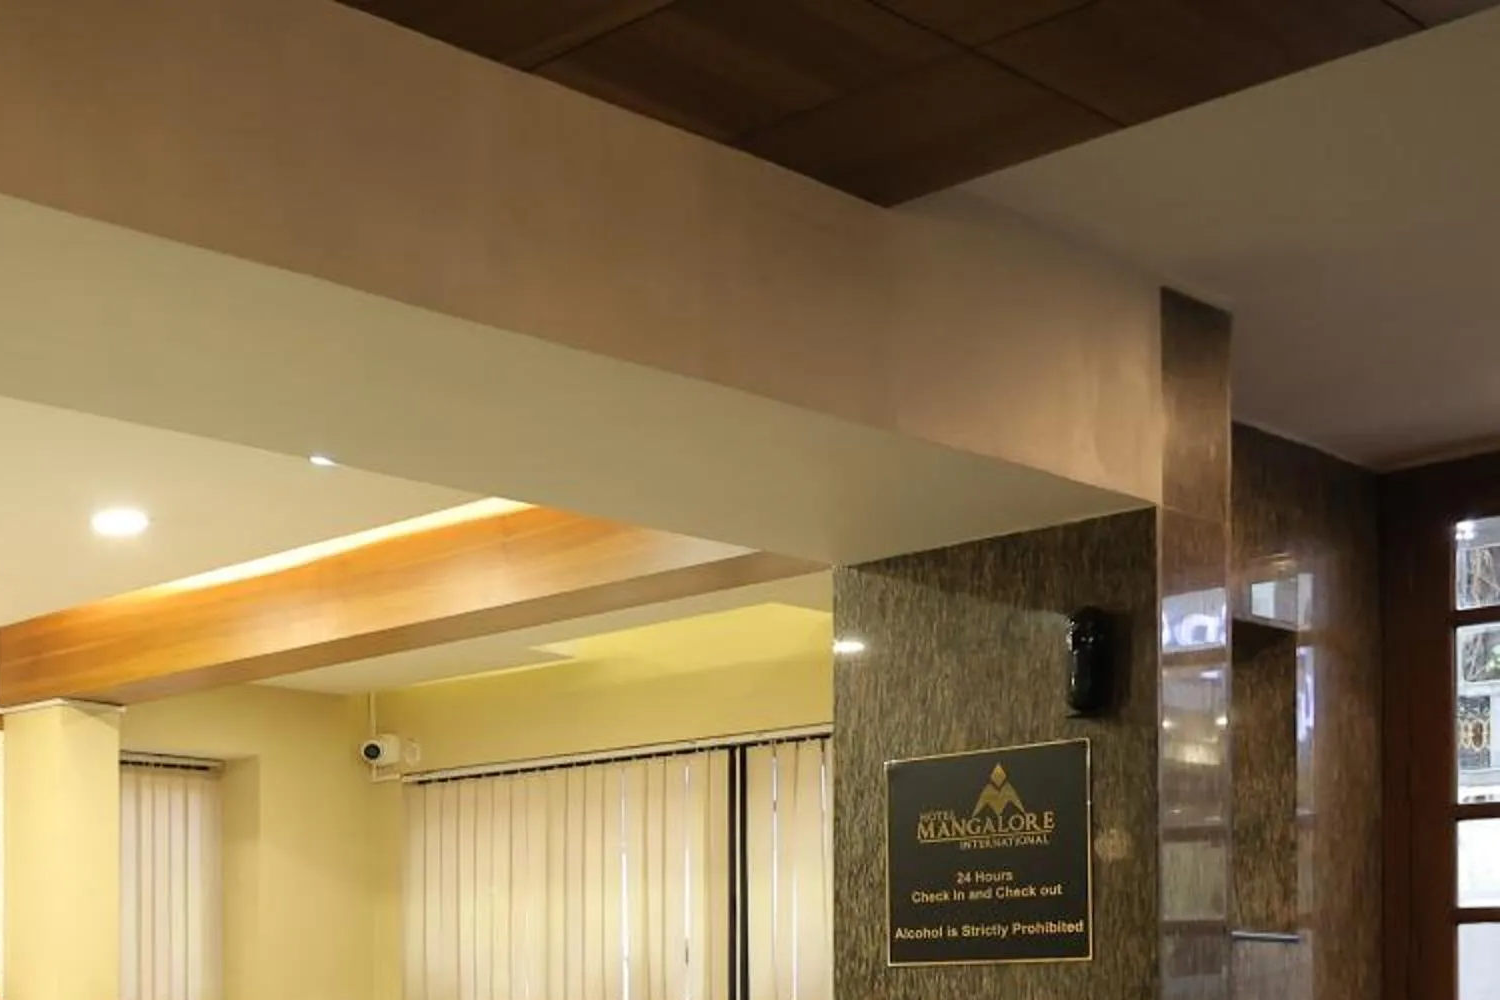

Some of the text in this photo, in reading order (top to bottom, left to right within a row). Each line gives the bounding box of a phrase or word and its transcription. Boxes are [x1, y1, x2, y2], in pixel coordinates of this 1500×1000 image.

[917, 811, 1056, 840] MANGALORE
[960, 835, 1049, 849] INTERNATIONAL
[956, 870, 1013, 885] 24 Hours
[911, 889, 950, 904] Check
[968, 888, 993, 901] and
[995, 885, 1037, 899] Check
[1040, 883, 1063, 896] out
[895, 920, 1085, 940] Alcohol is Strictly Prohibited
